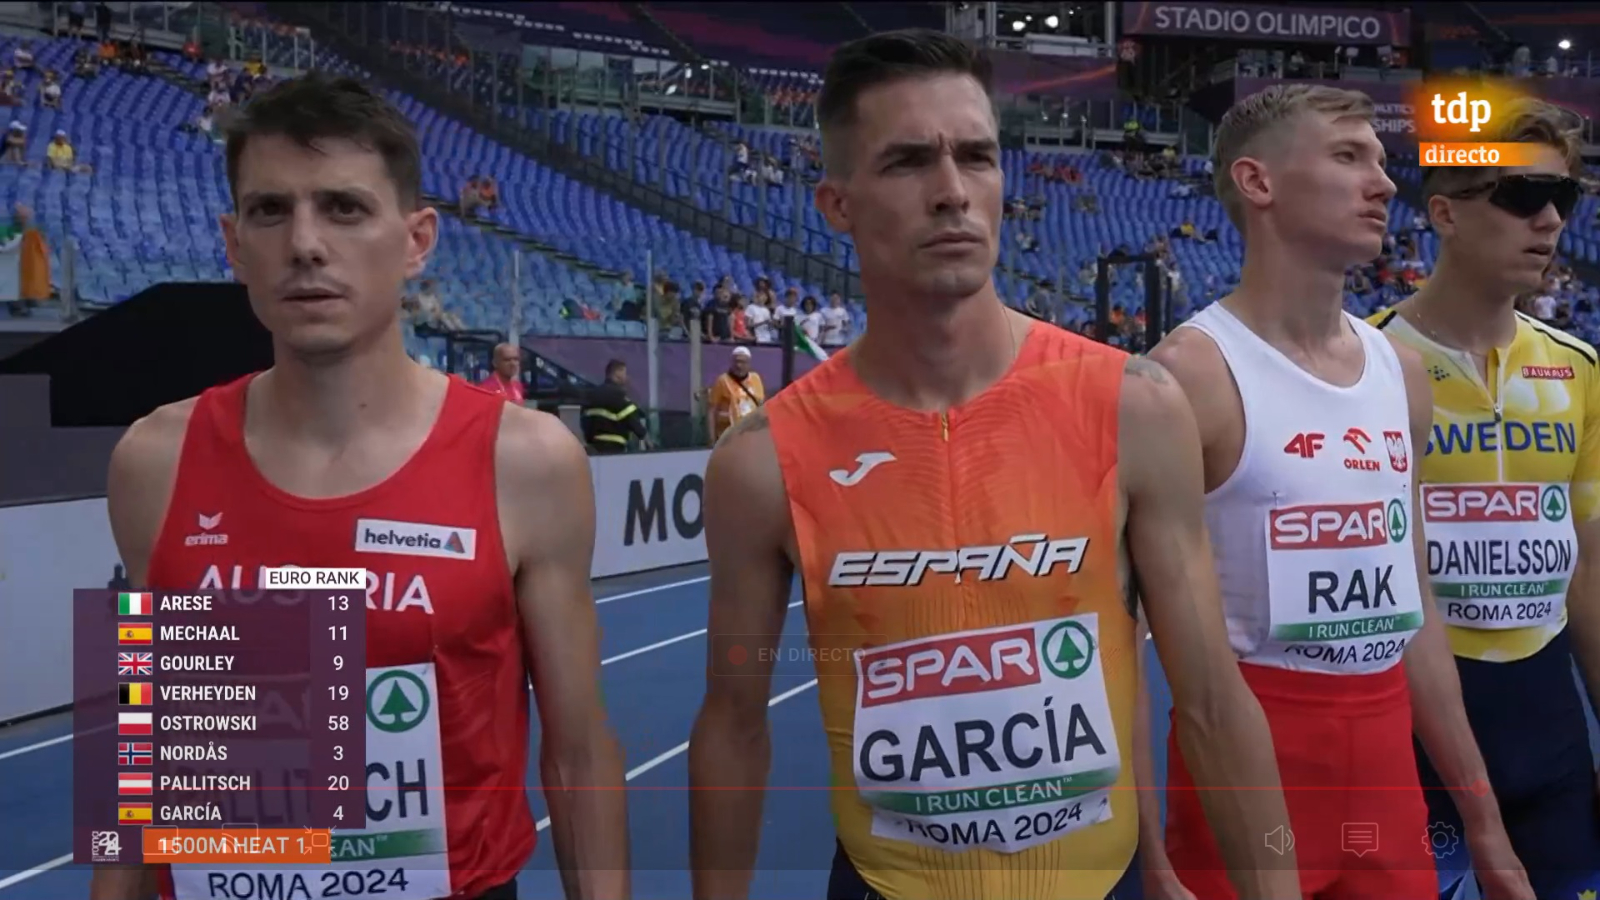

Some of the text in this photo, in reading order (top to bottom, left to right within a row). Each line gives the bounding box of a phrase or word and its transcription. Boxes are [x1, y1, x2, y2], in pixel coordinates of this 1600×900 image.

[1156, 6, 1381, 40] STADIO OLIMPICO
[1522, 366, 1574, 379] BAUHAUS
[1343, 458, 1381, 472] ORLEN
[1425, 488, 1539, 519] SPAR
[184, 532, 229, 547] erima
[364, 527, 442, 550] helvetia
[1273, 507, 1386, 544] SPAR
[827, 533, 1090, 587] ESPAÑA
[1427, 539, 1572, 576] DANIELSSON
[1308, 564, 1397, 614] RAK
[1469, 584, 1501, 597] RUN
[1447, 600, 1552, 621] ROMA 2024
[1317, 623, 1349, 638] RUN
[866, 637, 1034, 699] SPAR
[859, 697, 1107, 783] GARCÍA
[927, 791, 980, 813] RUN
[1014, 802, 1083, 841] 2024
[208, 866, 409, 900] ROMA 2024
